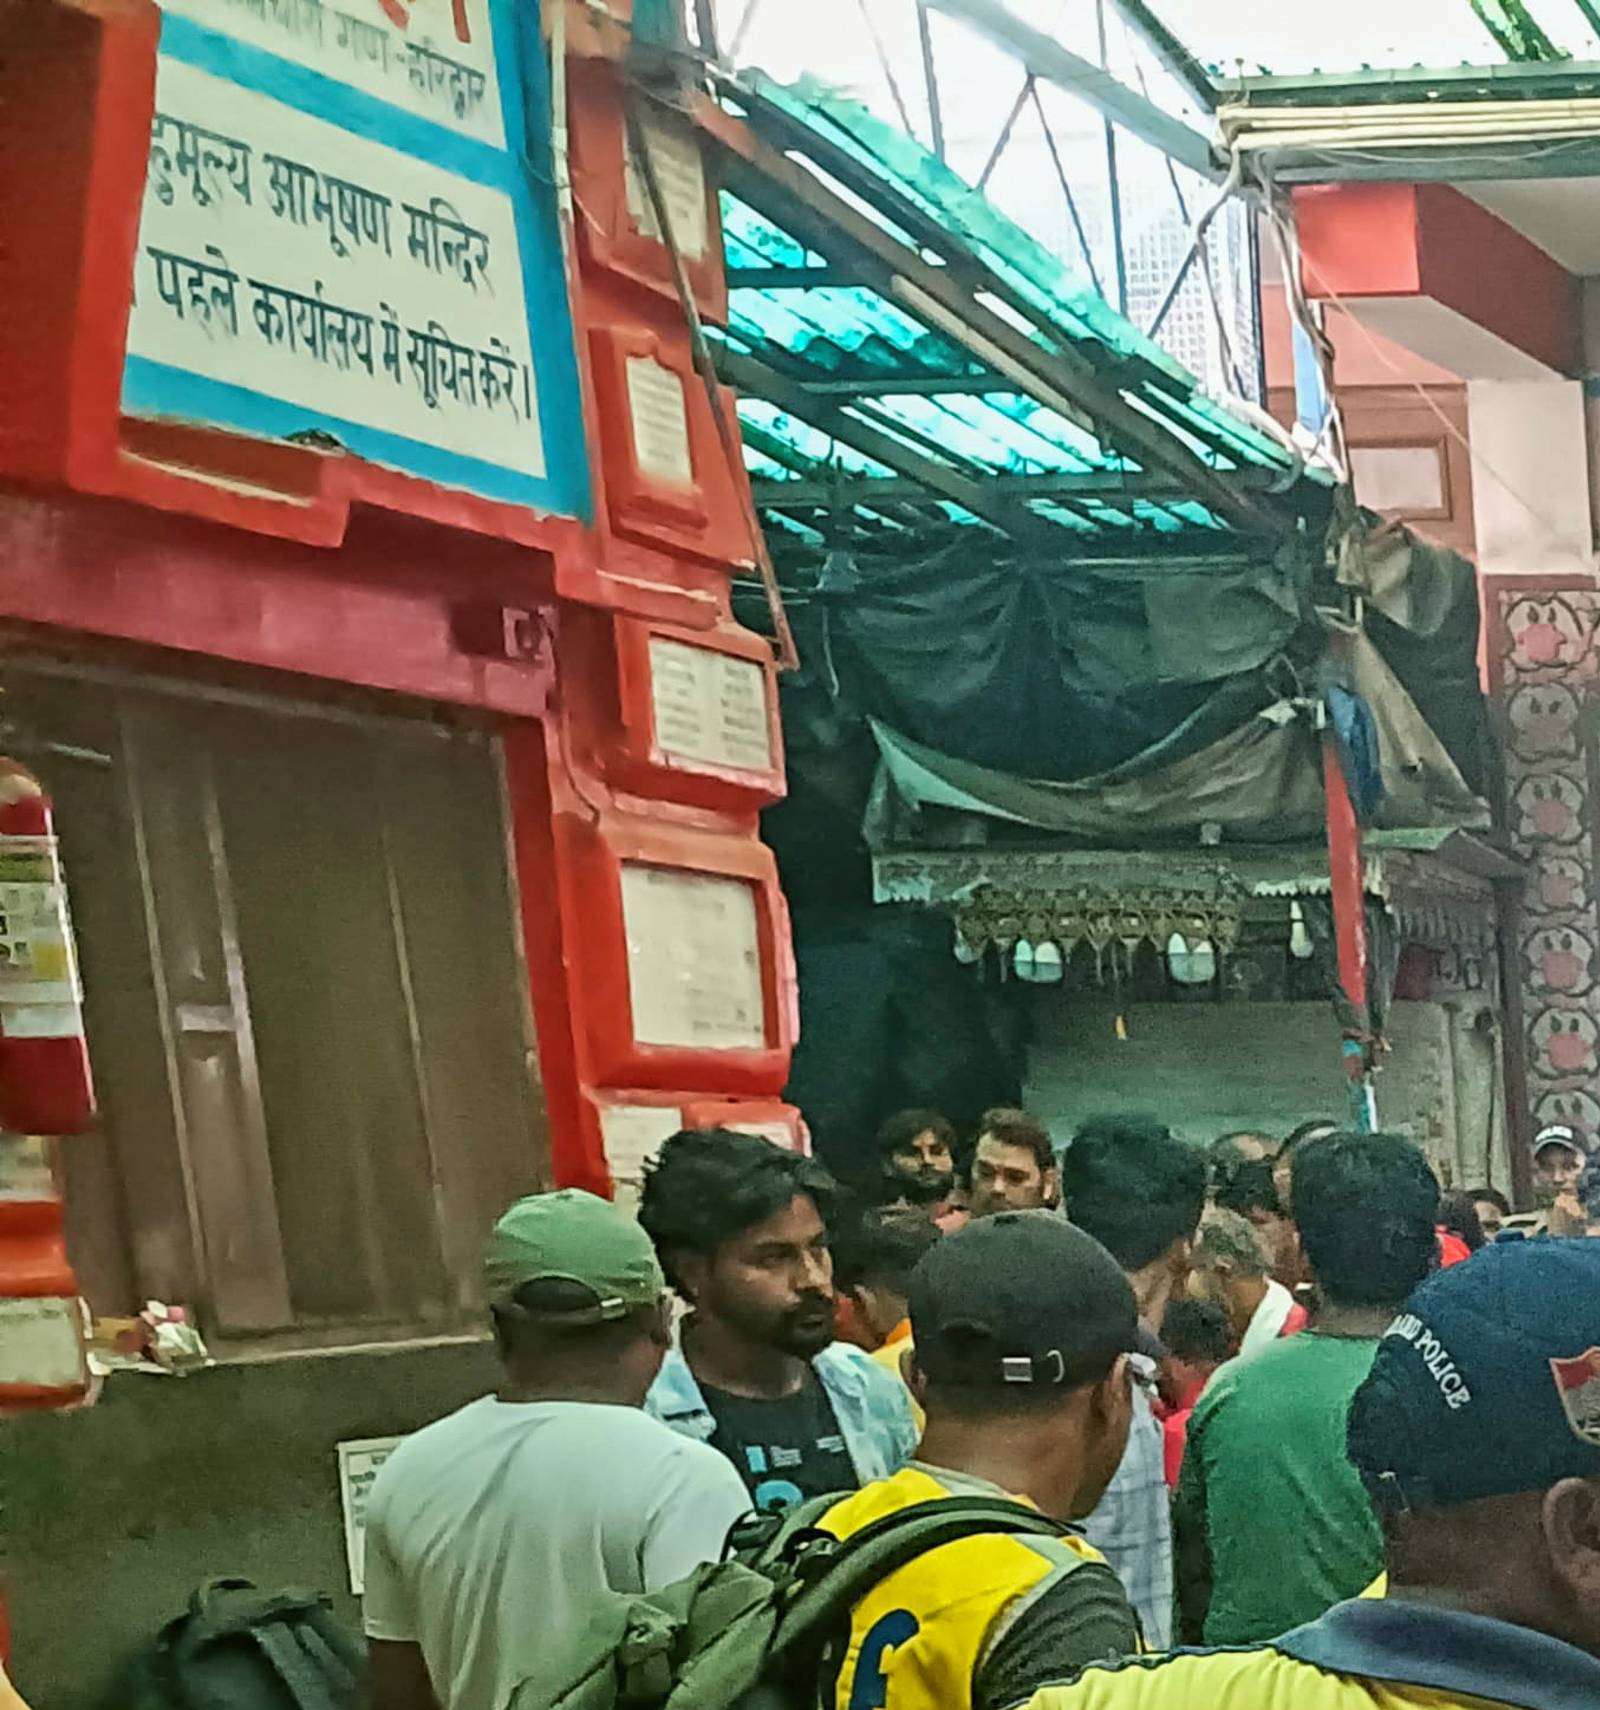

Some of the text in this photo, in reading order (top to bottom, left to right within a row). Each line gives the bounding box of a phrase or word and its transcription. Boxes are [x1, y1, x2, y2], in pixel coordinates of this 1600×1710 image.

[263, 152, 393, 258] आभूषण
[147, 245, 241, 339] पहले
[247, 280, 375, 377] कार्यालय
[406, 321, 477, 408] सूचित
[1413, 1328, 1472, 1410] POLICE
